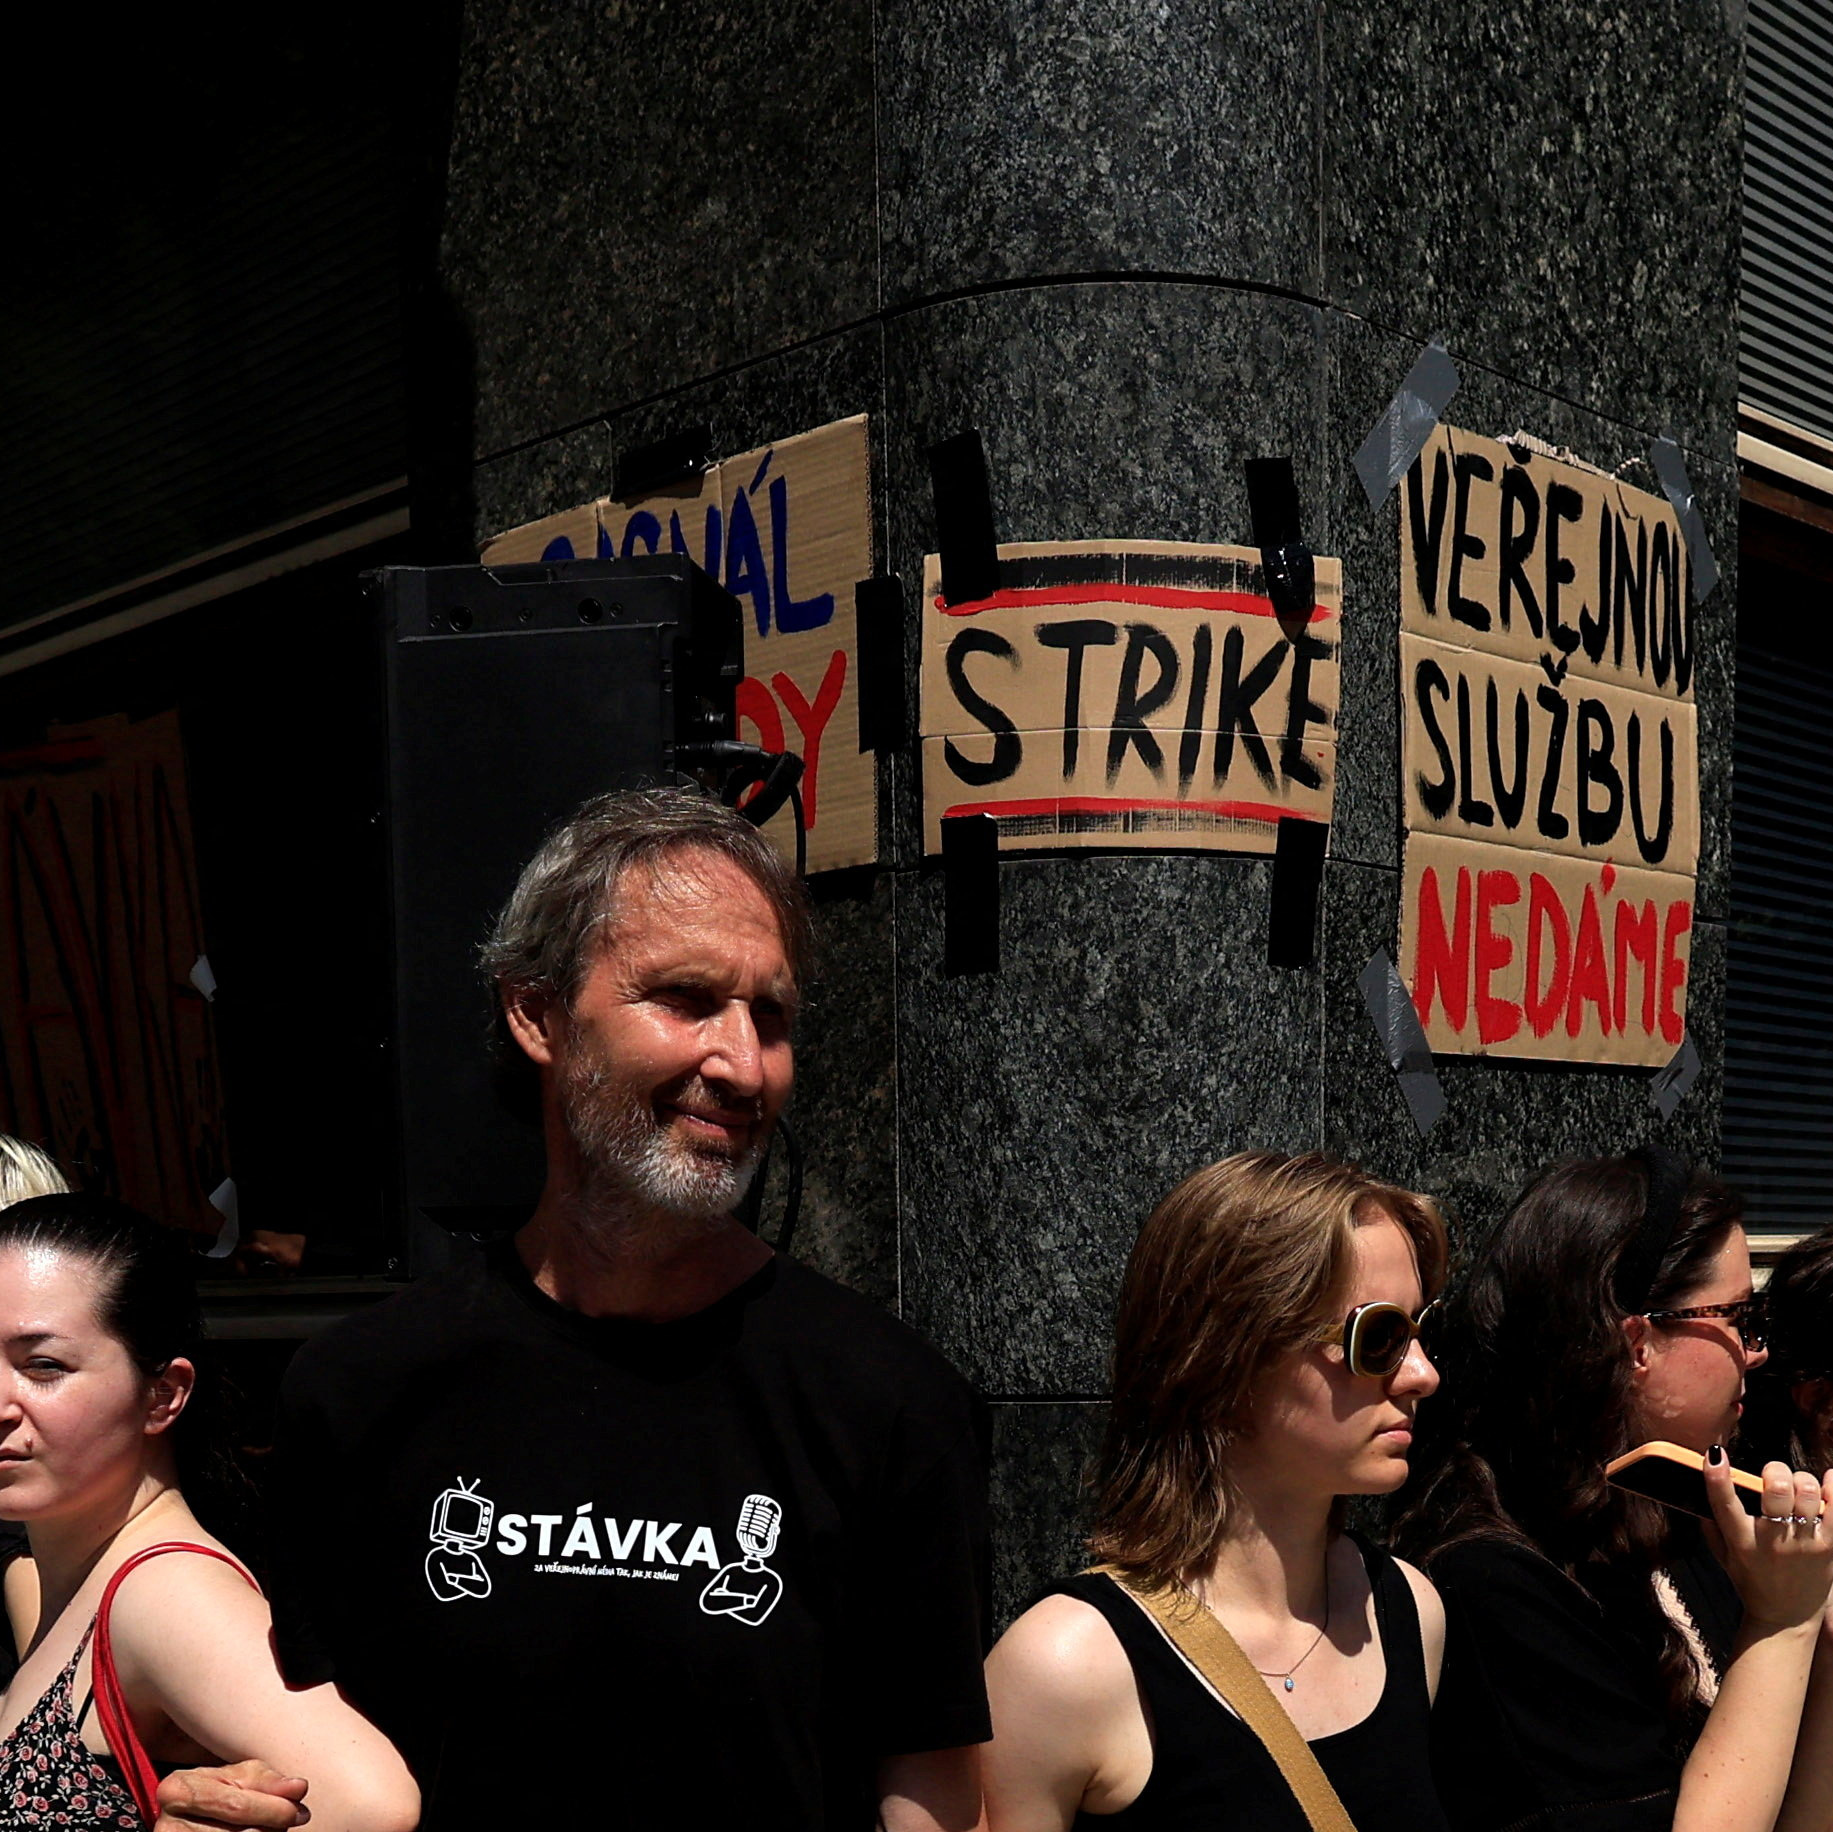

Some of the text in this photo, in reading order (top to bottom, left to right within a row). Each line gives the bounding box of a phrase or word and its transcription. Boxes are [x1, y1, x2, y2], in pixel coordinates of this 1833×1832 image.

[1408, 443, 1693, 696] VEŘEJNOU
[944, 619, 1334, 798] STRIKE
[1415, 652, 1674, 864] SLUŽBU
[1412, 858, 1691, 1045] NEDÁME
[496, 1501, 722, 1570] STÁVKA
